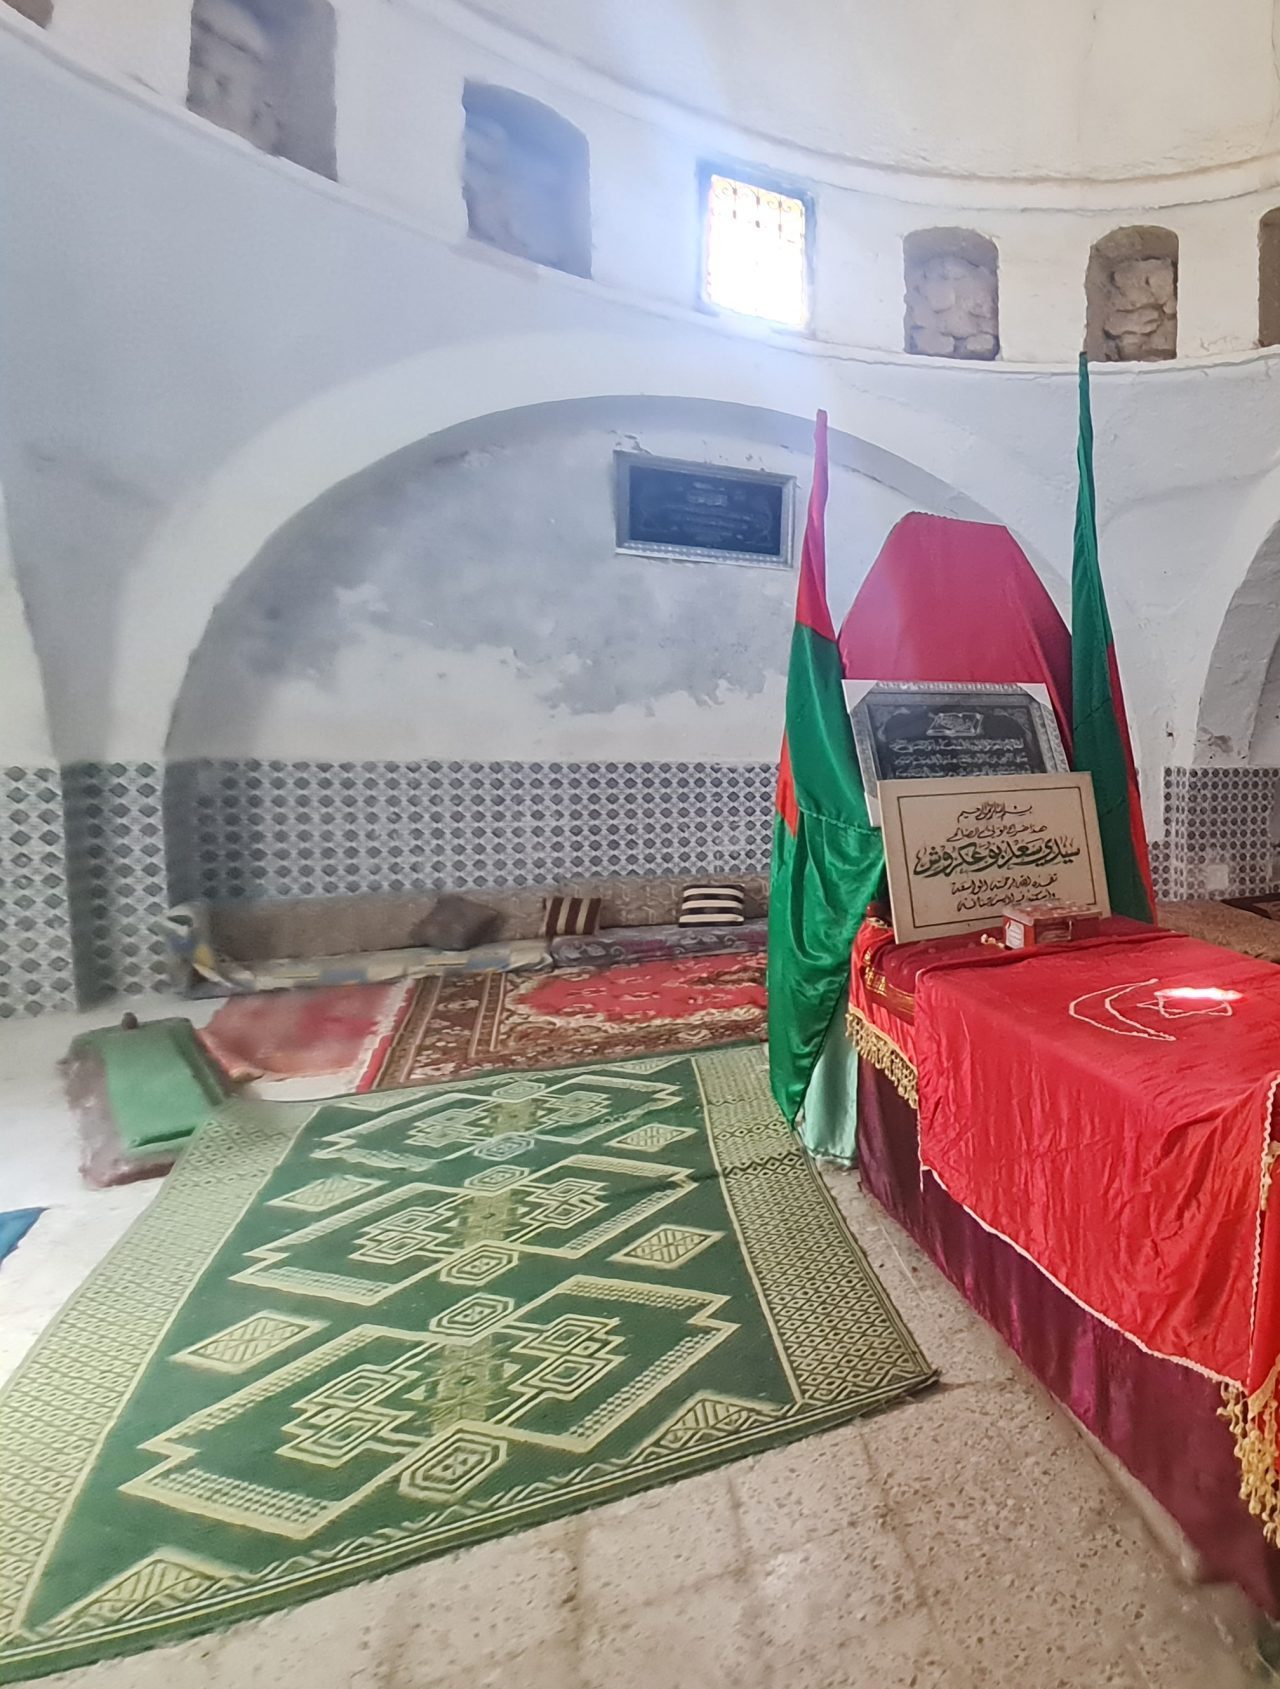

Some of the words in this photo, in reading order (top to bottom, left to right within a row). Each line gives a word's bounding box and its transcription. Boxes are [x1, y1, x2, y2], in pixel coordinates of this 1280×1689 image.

[1006, 824, 1030, 837] ضريح
[1029, 823, 1048, 834] هذا
[1009, 838, 1081, 869] سيدي
[951, 879, 988, 896] الواسعة
